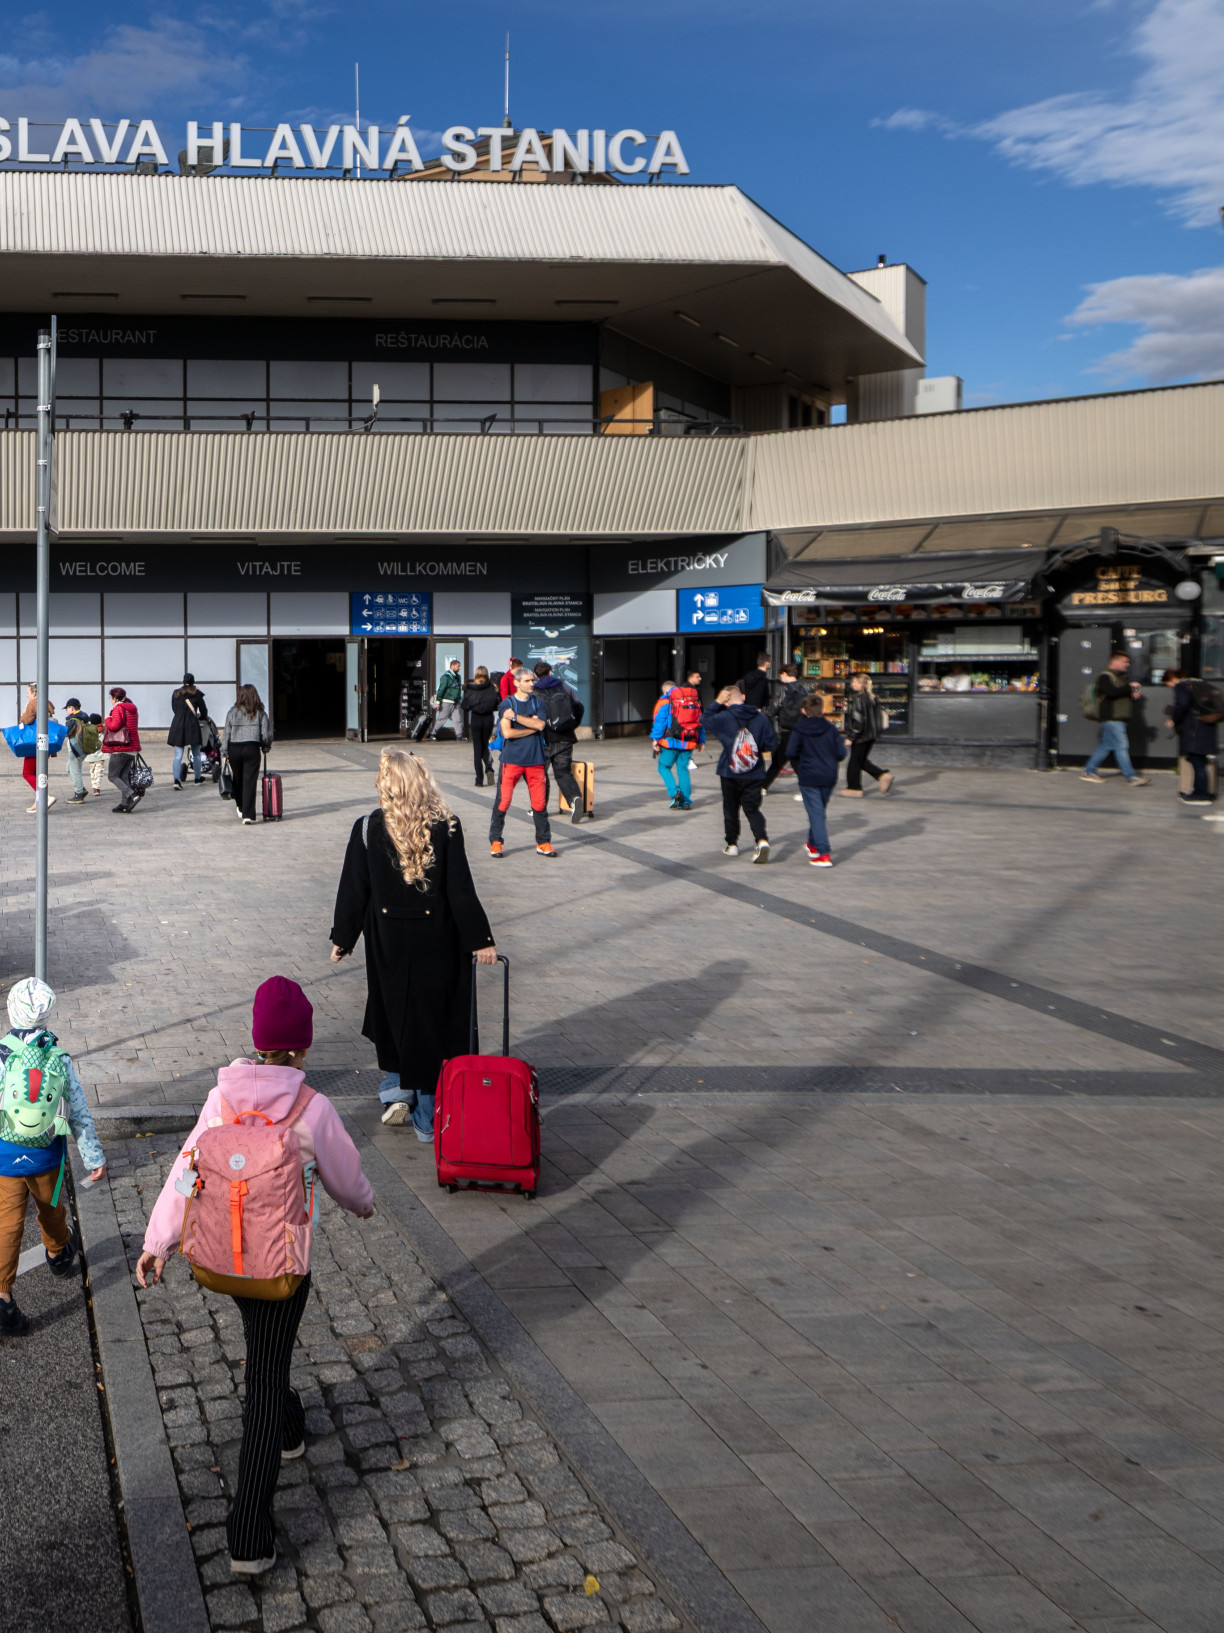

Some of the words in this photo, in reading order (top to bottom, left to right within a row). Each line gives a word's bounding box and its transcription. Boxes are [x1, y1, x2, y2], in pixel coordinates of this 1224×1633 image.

[186, 115, 425, 171] HLAVNÁ
[441, 126, 690, 176] STANICA
[56, 328, 157, 344] ESTAURANT
[375, 332, 489, 349] REŠTAURÁCIA
[59, 561, 146, 576] WELCOME
[237, 561, 302, 576] VITAJTE
[377, 561, 487, 576] WILLKOMMEN
[628, 552, 729, 574] ELEKTRIČKY
